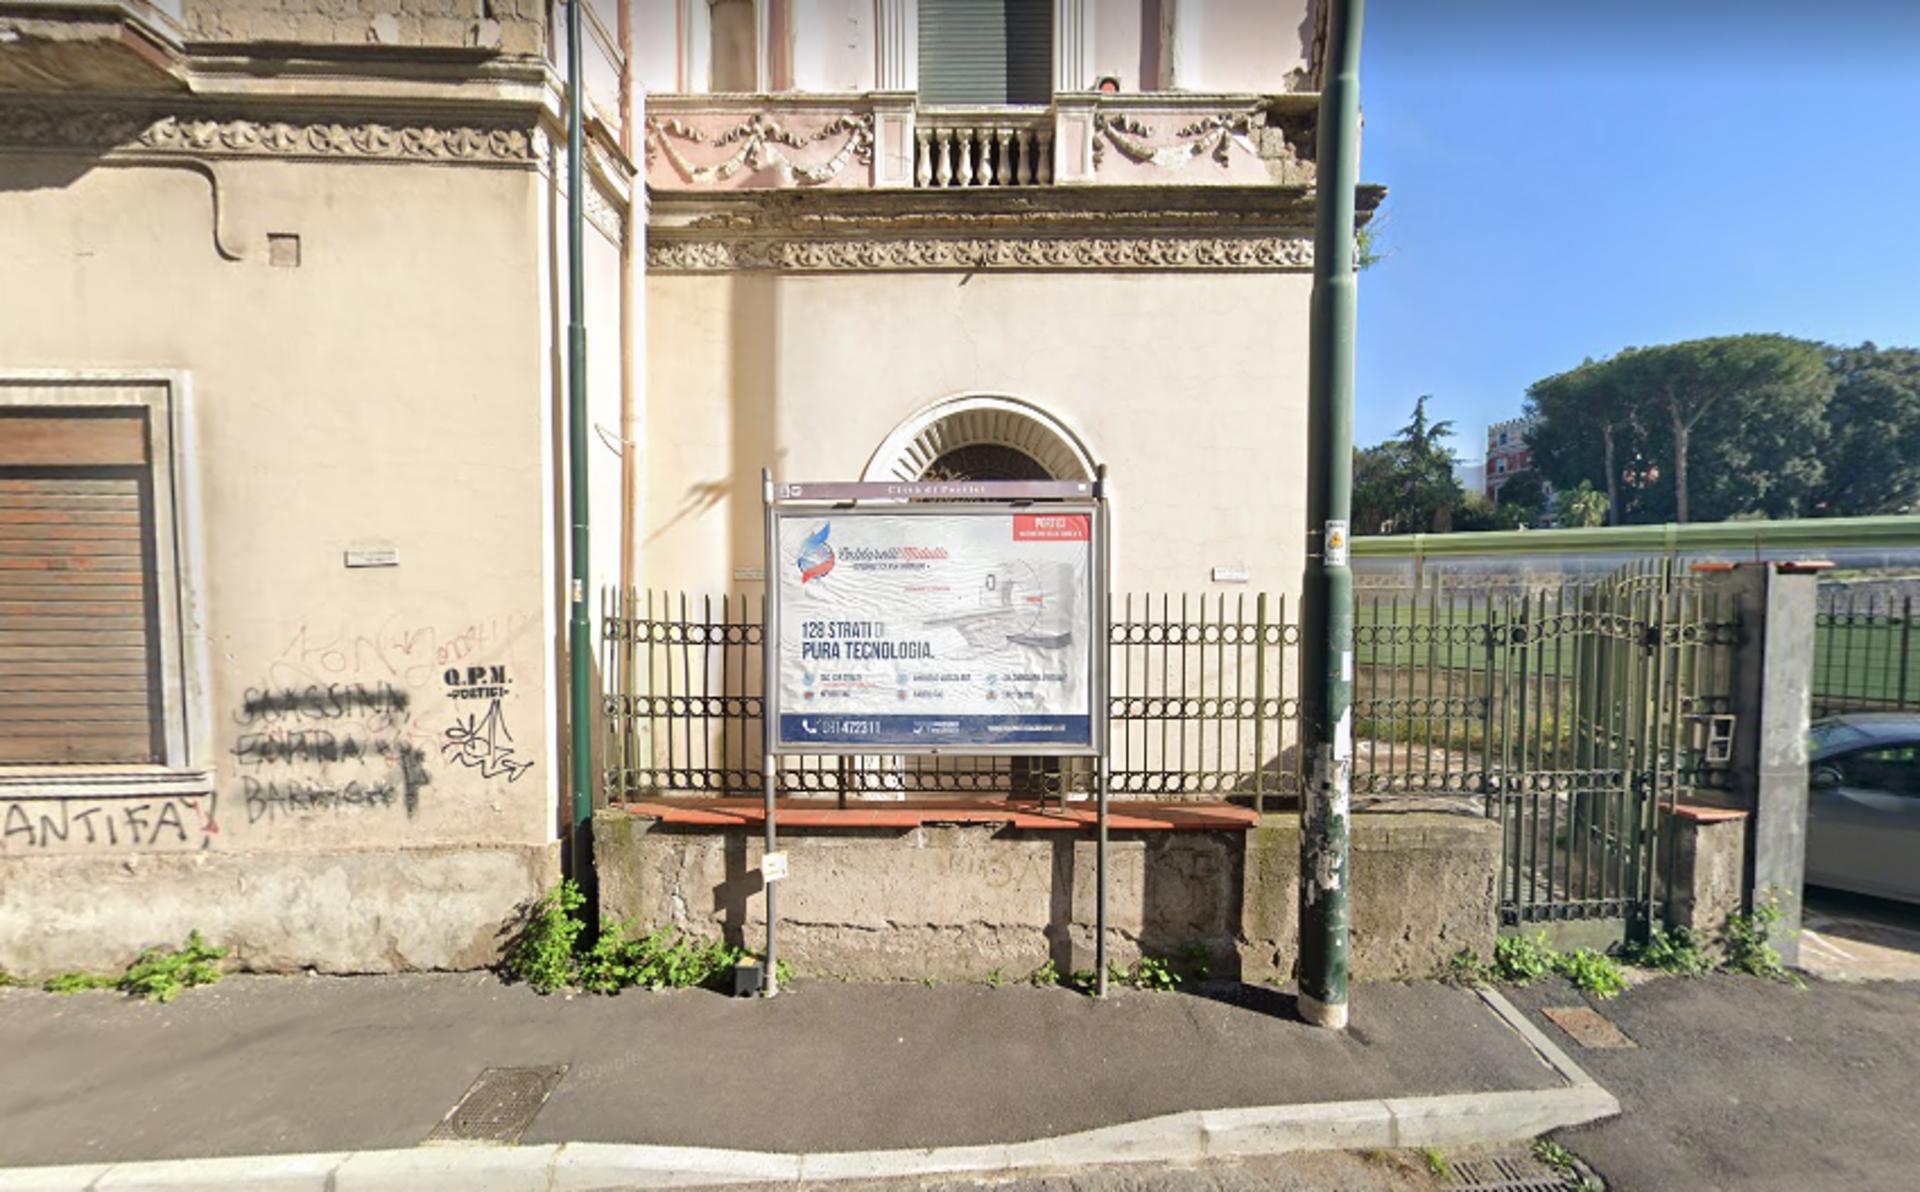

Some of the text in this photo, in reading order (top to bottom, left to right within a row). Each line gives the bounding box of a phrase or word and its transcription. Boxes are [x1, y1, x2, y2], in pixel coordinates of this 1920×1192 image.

[801, 621, 826, 639] 128
[827, 621, 872, 639] STRATI
[802, 641, 936, 660] PURA TECNOLOGIA.
